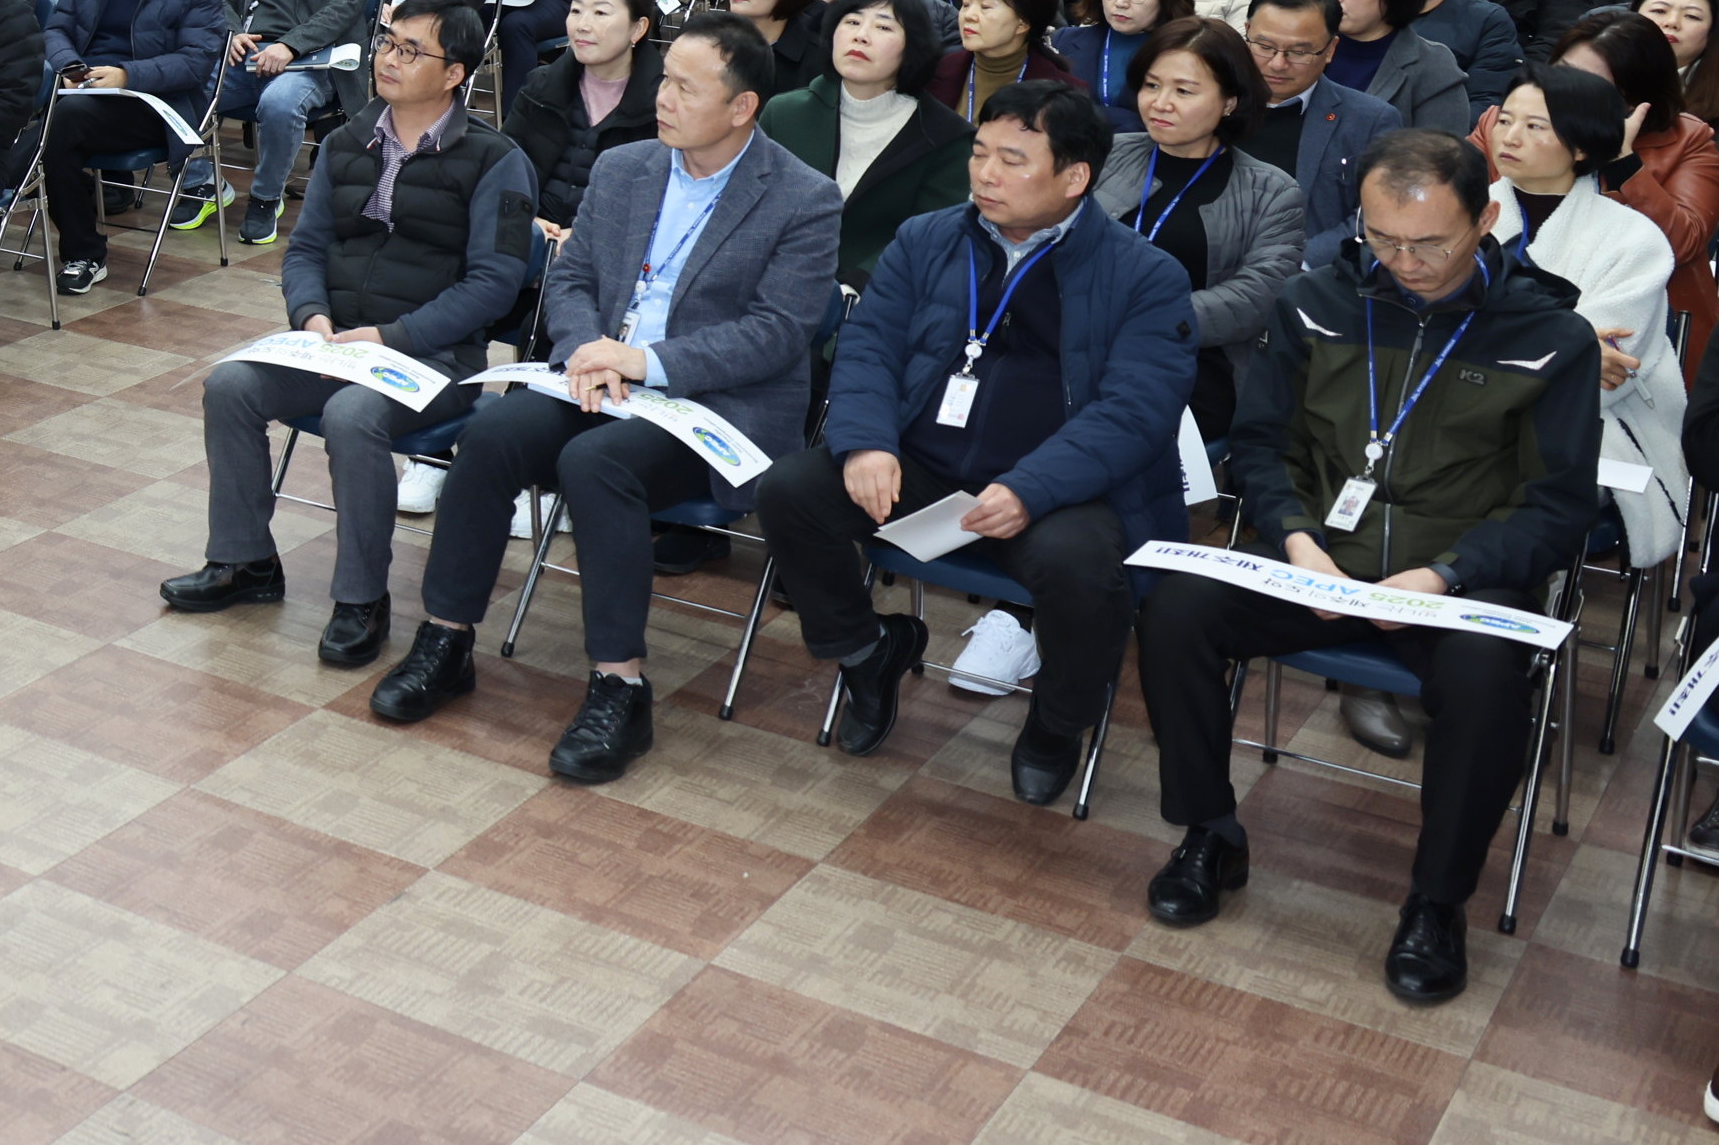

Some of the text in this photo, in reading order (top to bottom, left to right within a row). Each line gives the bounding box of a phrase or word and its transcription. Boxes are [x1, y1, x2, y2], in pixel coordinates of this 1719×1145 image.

[320, 343, 370, 358] 2025
[1458, 369, 1485, 385] K2
[637, 394, 694, 415] 2025
[1270, 569, 1361, 595] APEC
[1369, 592, 1446, 610] 2025
